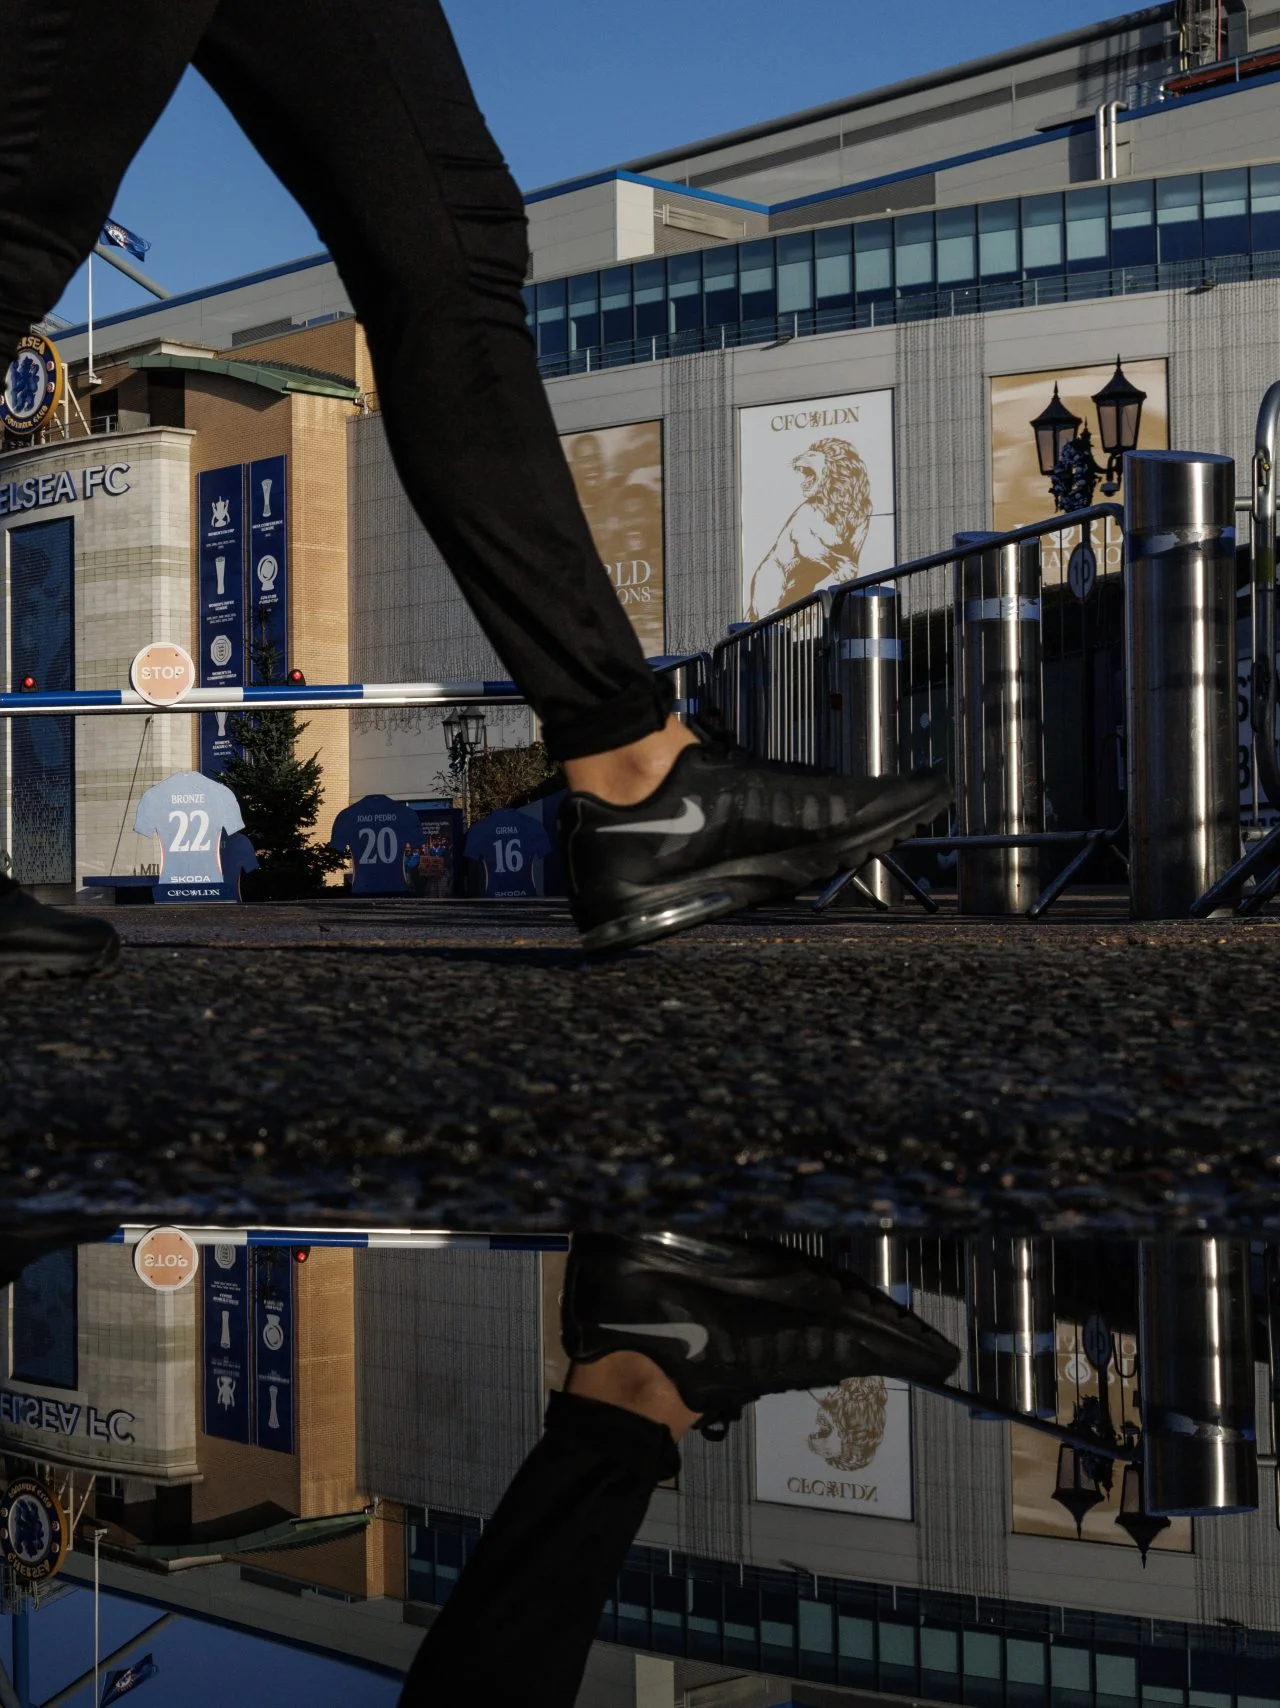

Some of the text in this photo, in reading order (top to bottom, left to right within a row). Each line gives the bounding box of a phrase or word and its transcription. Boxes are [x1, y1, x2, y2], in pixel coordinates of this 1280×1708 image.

[770, 406, 861, 432] CFC LDN
[82, 462, 131, 500] FC
[141, 665, 185, 680] STOP
[171, 793, 205, 805] BRONZE
[374, 813, 397, 822] PEDRO
[495, 826, 518, 835] GIRMA
[168, 809, 211, 853] 22
[358, 826, 398, 865] 20
[493, 838, 524, 873] 16
